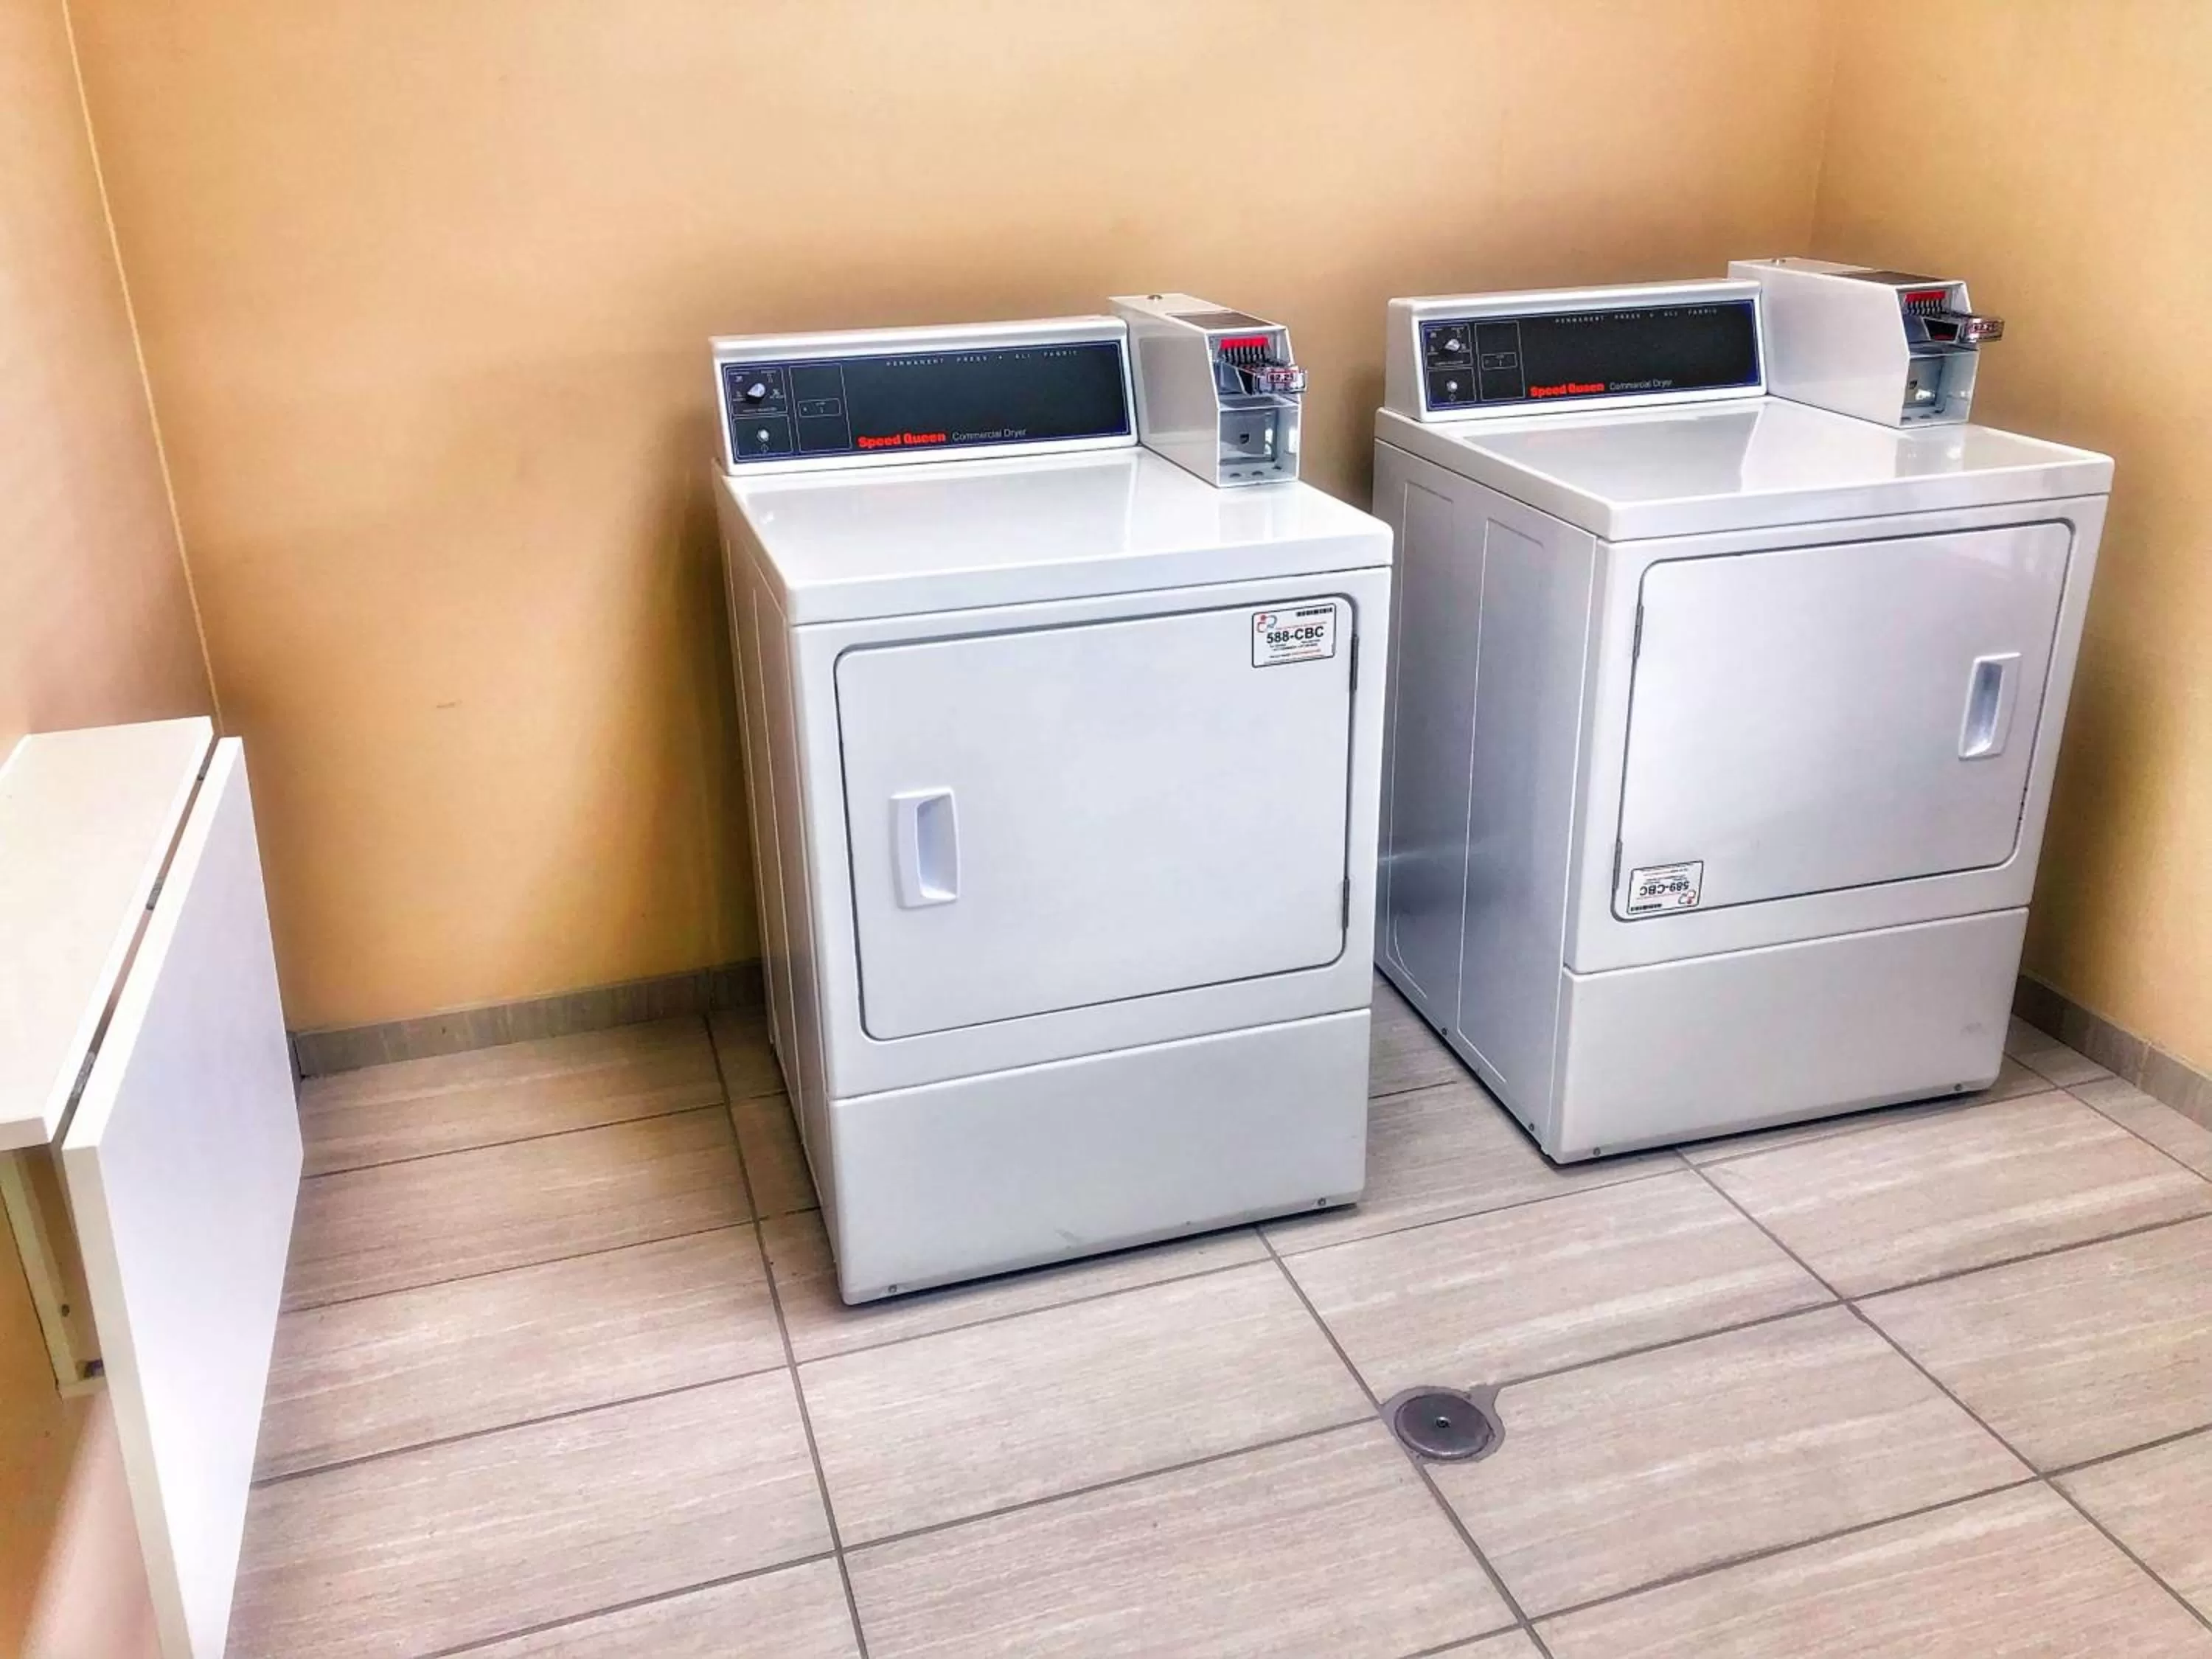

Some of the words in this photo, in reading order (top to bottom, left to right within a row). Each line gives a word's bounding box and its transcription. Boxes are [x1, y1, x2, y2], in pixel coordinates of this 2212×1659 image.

[1530, 384, 1567, 398] Speed
[1568, 382, 1605, 394] Queen
[1609, 379, 1652, 391] Commercial
[858, 434, 901, 449] Speed
[903, 432, 946, 445] Queen
[951, 428, 1002, 442] Commercial
[1003, 427, 1027, 438] Dryer
[1267, 626, 1324, 643] 588-CBC
[1639, 881, 1690, 896] 589-CBC
